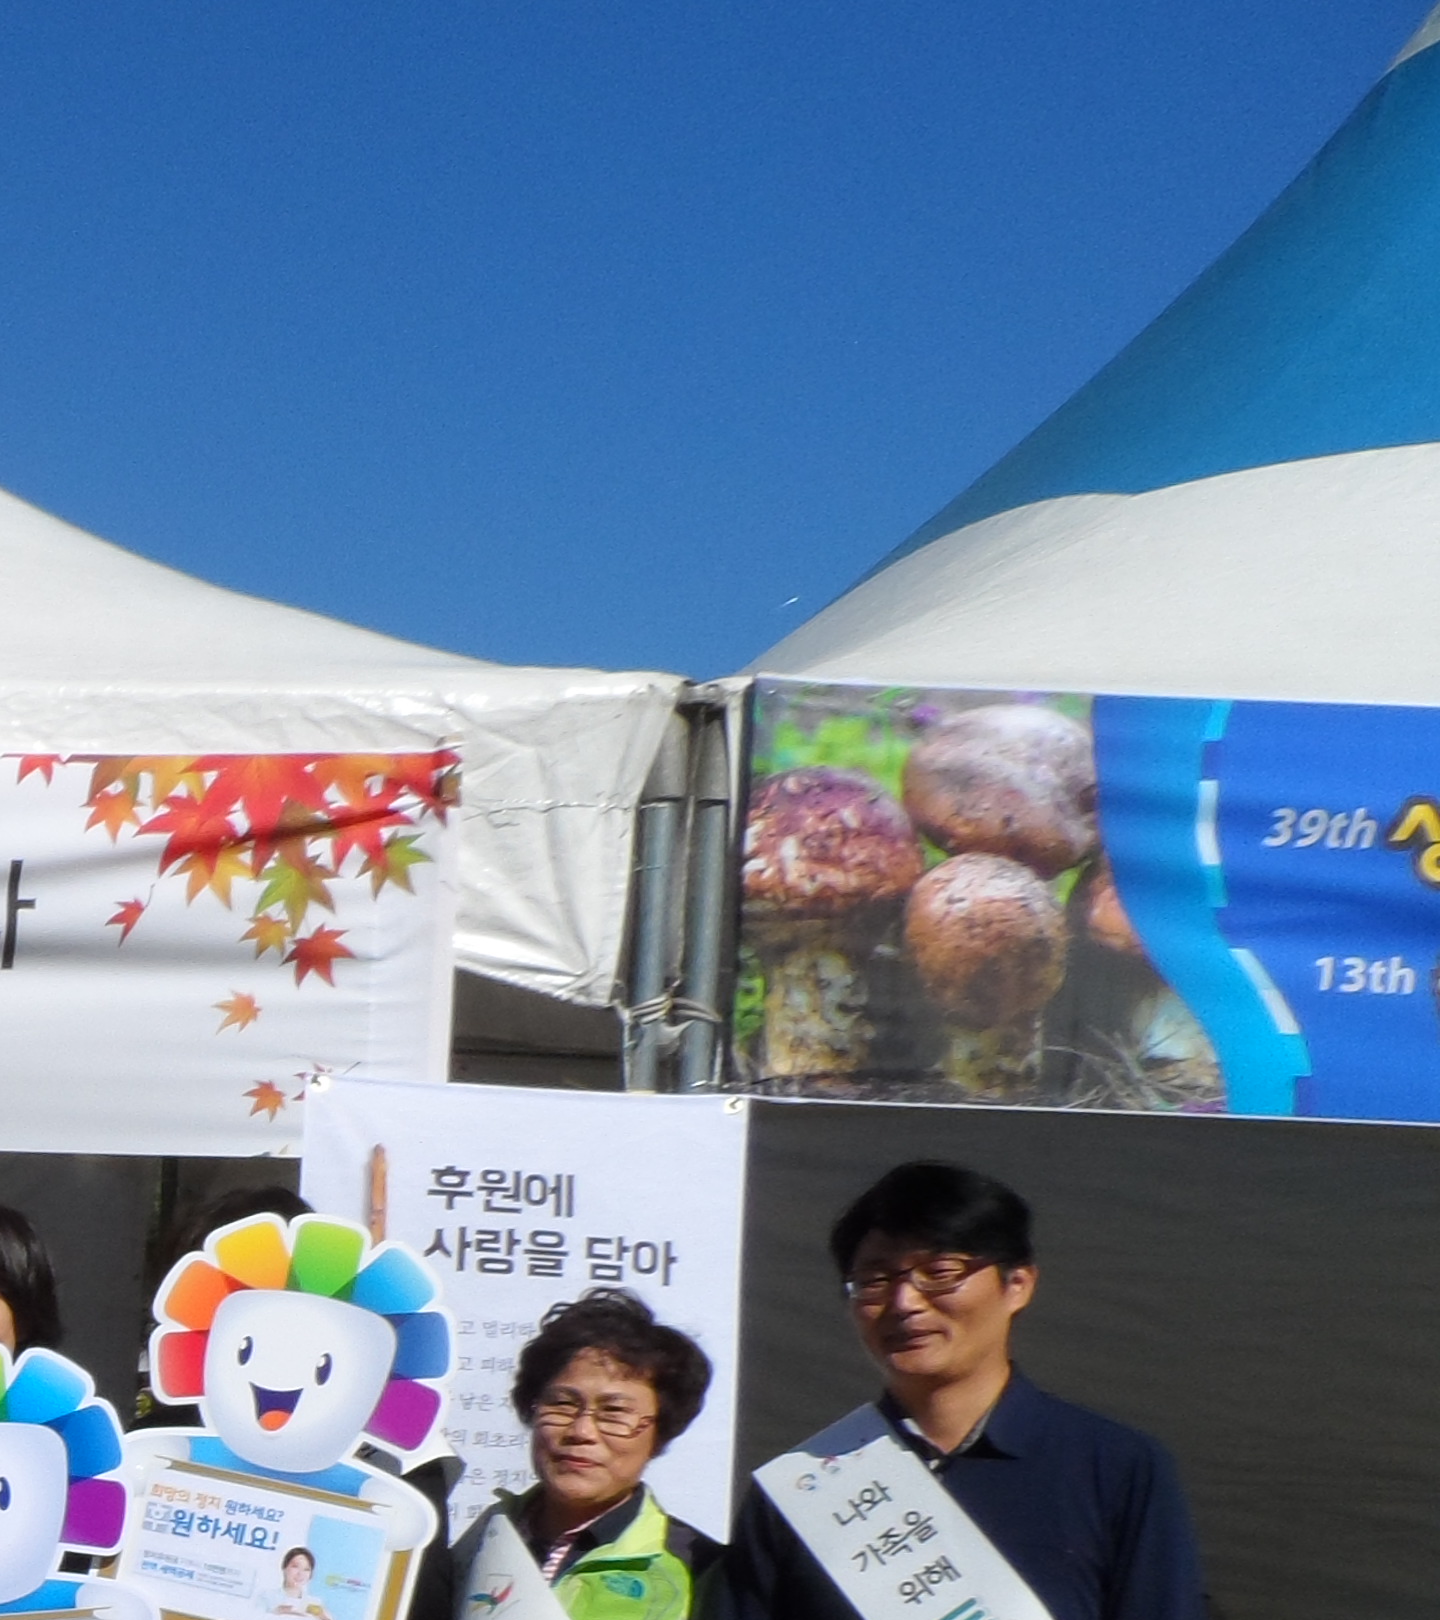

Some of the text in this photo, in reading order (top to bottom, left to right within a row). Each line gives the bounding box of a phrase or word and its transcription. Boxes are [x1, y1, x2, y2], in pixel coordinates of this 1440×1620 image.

[1260, 806, 1379, 851] 39th
[1314, 956, 1416, 996] 13th
[426, 1164, 575, 1219] 후원에
[422, 1225, 679, 1287] 사랑을 담아
[832, 1479, 893, 1528] 나와
[851, 1509, 940, 1573] 가족을
[897, 1554, 963, 1605] 위해
